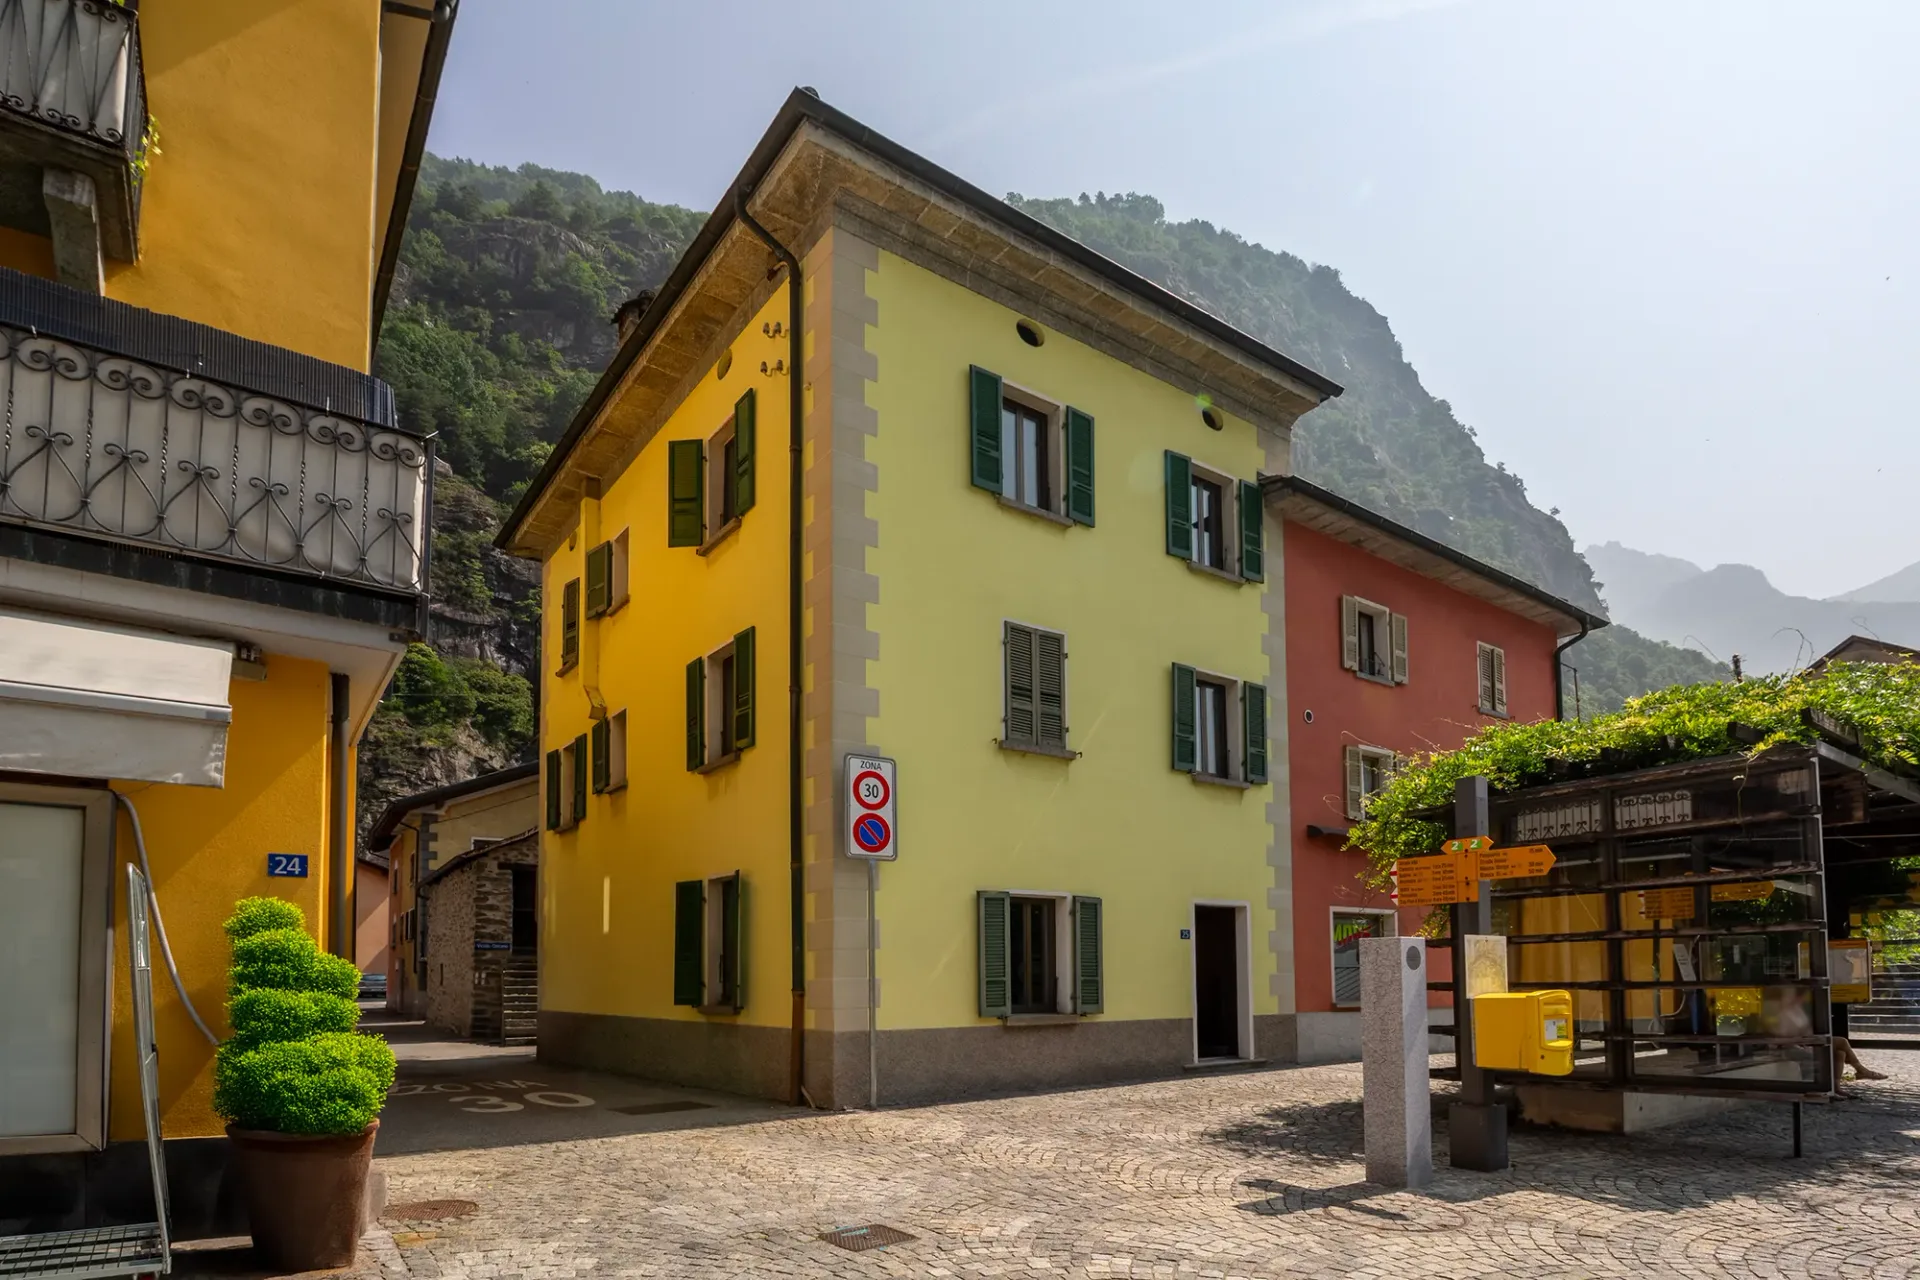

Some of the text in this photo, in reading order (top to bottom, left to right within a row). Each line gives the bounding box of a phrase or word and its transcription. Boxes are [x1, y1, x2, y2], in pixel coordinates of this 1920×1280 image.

[860, 760, 882, 770] ZONA
[864, 783, 879, 798] 30
[1451, 841, 1459, 850] 2
[1470, 839, 1478, 848] 2
[274, 856, 301, 875] 24
[386, 1079, 549, 1096] ZONA
[449, 1091, 596, 1113] 30
